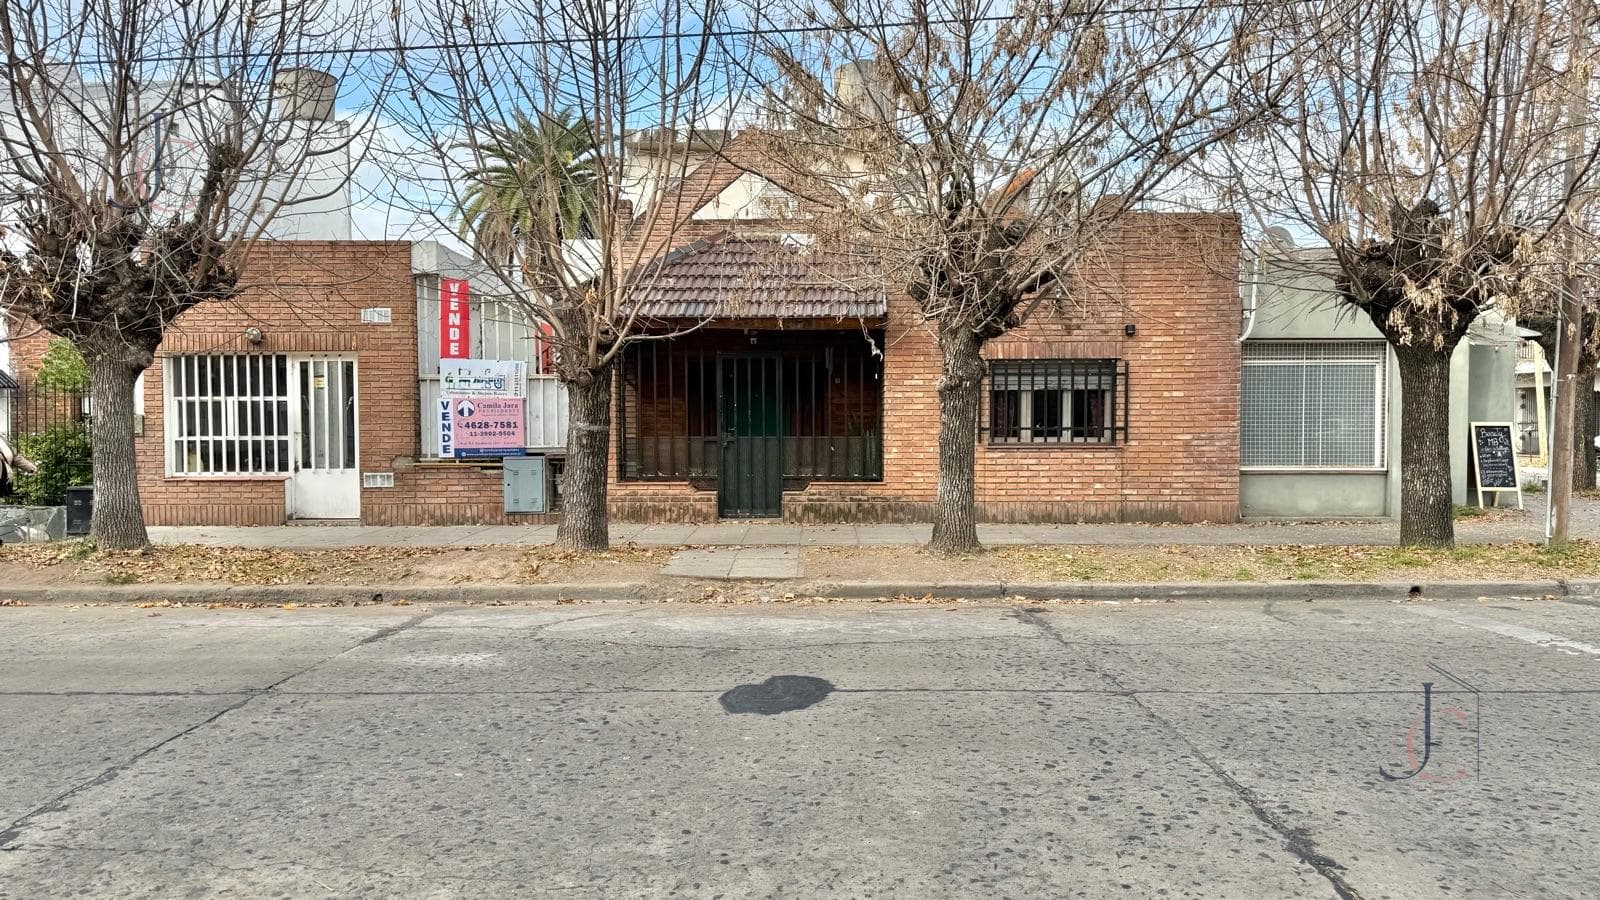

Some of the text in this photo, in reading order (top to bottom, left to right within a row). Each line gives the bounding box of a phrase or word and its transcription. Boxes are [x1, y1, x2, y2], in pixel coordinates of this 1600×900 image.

[448, 282, 460, 355] VENDE
[441, 401, 452, 454] VENDE
[464, 421, 518, 429] 4628-7581
